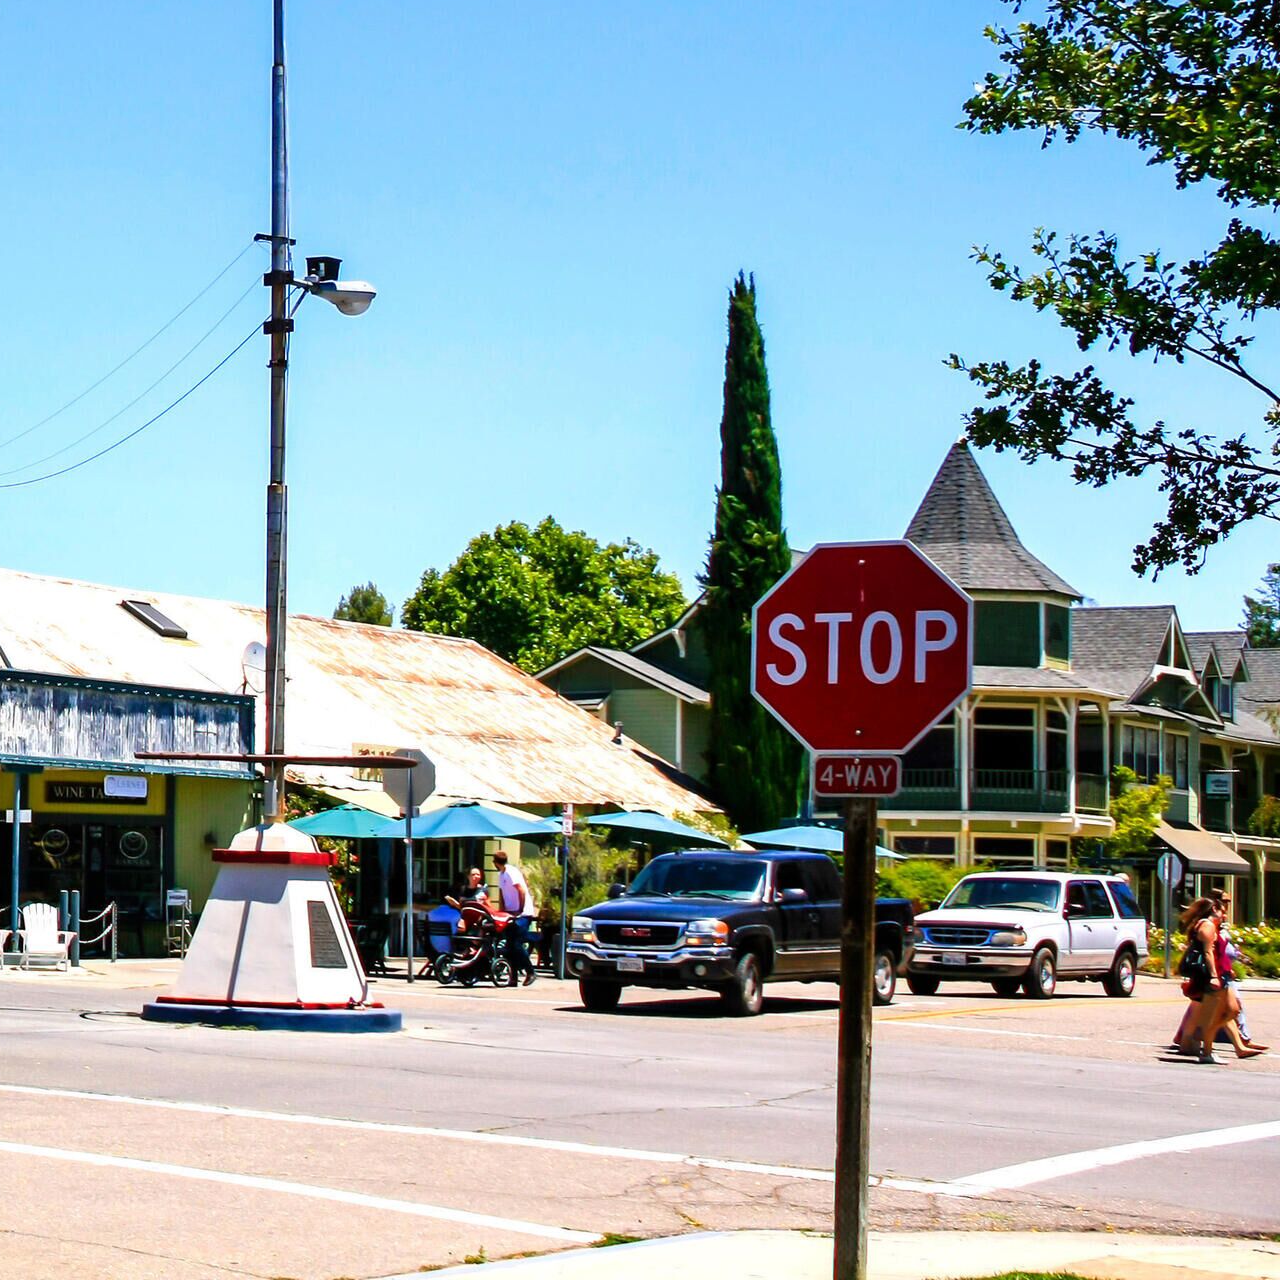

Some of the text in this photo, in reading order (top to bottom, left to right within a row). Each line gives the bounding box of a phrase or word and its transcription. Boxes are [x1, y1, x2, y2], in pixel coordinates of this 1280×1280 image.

[765, 609, 959, 686] STOP
[819, 764, 892, 787] 4-WAY
[53, 785, 85, 799] WINE
